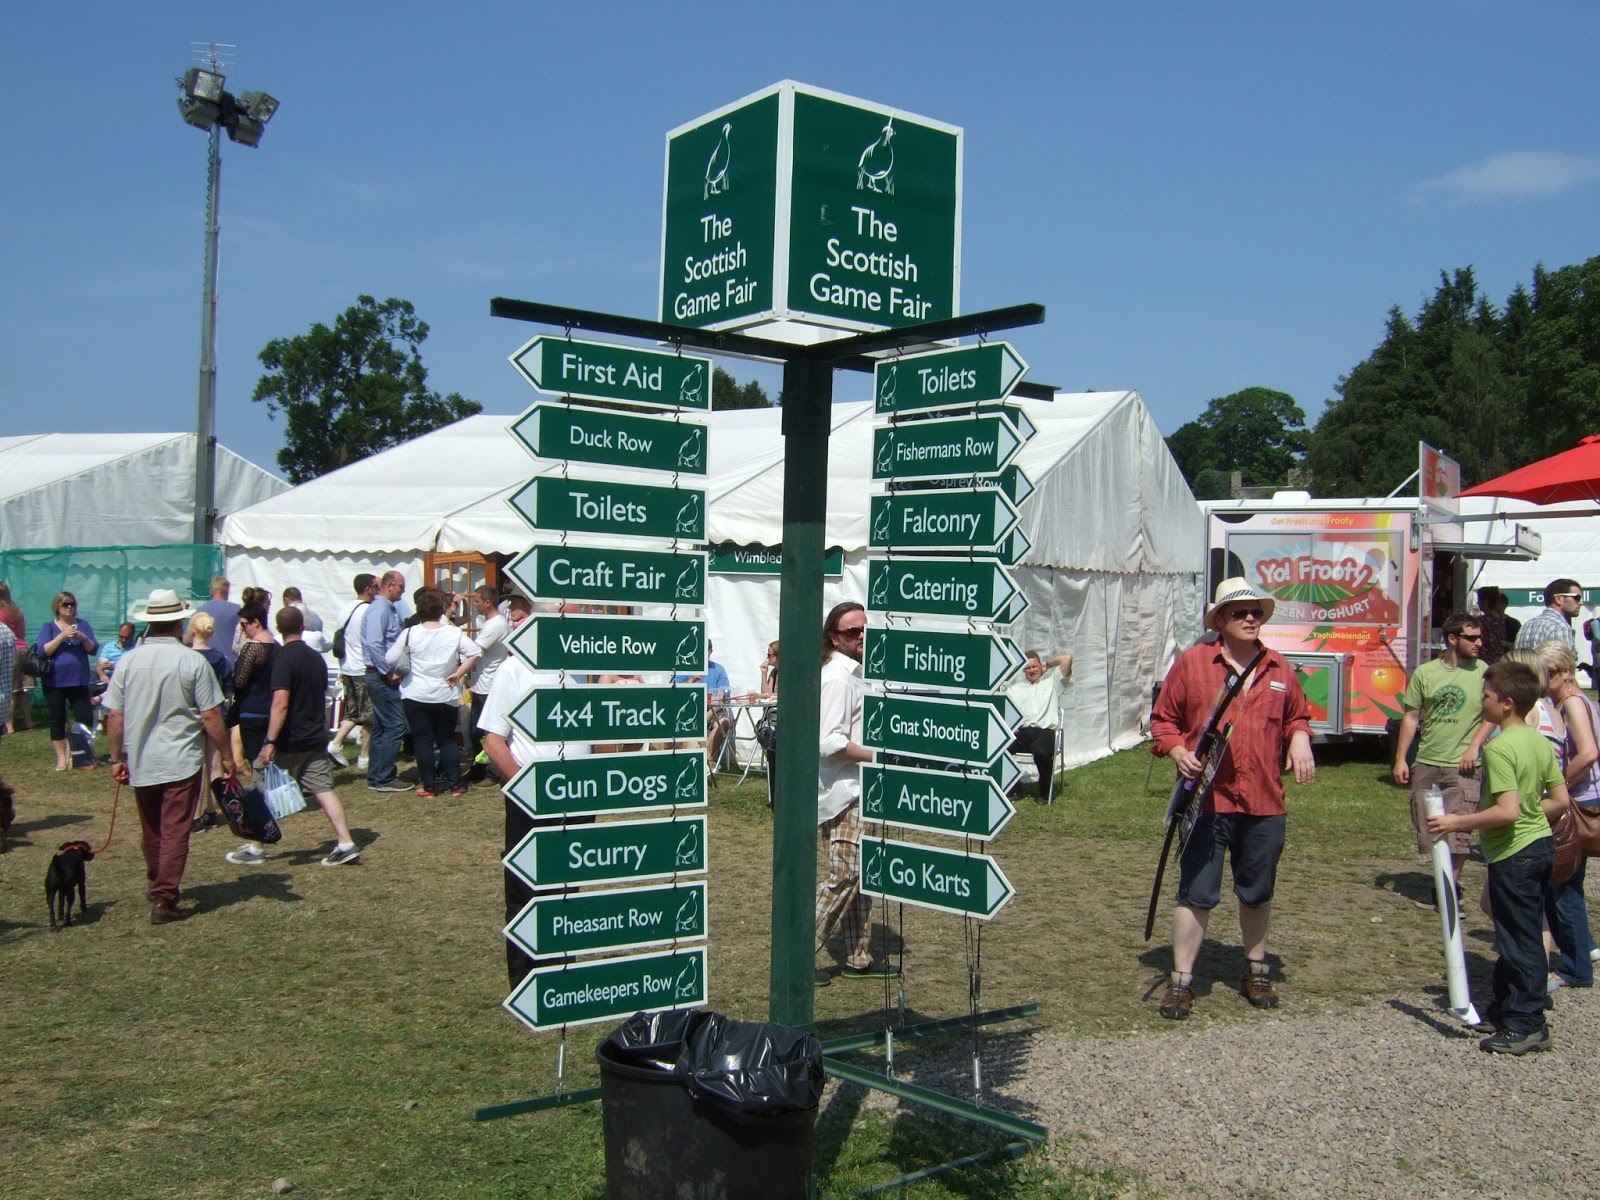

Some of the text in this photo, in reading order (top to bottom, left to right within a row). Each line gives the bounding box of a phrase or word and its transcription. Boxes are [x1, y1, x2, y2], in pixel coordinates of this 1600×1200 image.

[701, 214, 731, 242] The
[852, 206, 897, 242] The
[684, 241, 746, 283] Scottish
[826, 238, 918, 282] Scottish
[675, 277, 757, 319] Game Fair
[810, 273, 931, 319] Game Fair
[563, 354, 661, 390] First Aid
[918, 366, 975, 394] Toilets
[571, 426, 652, 452] Duck Row
[897, 437, 994, 461] Fishermans Row
[569, 492, 646, 522] Toilets
[904, 508, 981, 540] Falconry
[550, 559, 665, 589] Craft Fair
[1260, 560, 1367, 588] Yo! Frooty
[900, 574, 978, 610] Catering
[1311, 598, 1370, 620] YOGHURT
[560, 635, 656, 654] Vehicle Row
[905, 644, 965, 681] Fishing
[548, 701, 665, 727] 4x4 Track
[890, 715, 979, 749] Gnat Shooting
[546, 770, 667, 800] Gun Dogs
[898, 785, 972, 826] Archery
[569, 842, 647, 870] Scurry
[890, 858, 970, 896] Go Karts
[554, 909, 662, 935] Pheasant Row
[544, 975, 672, 1008] Gamekeepers Row
